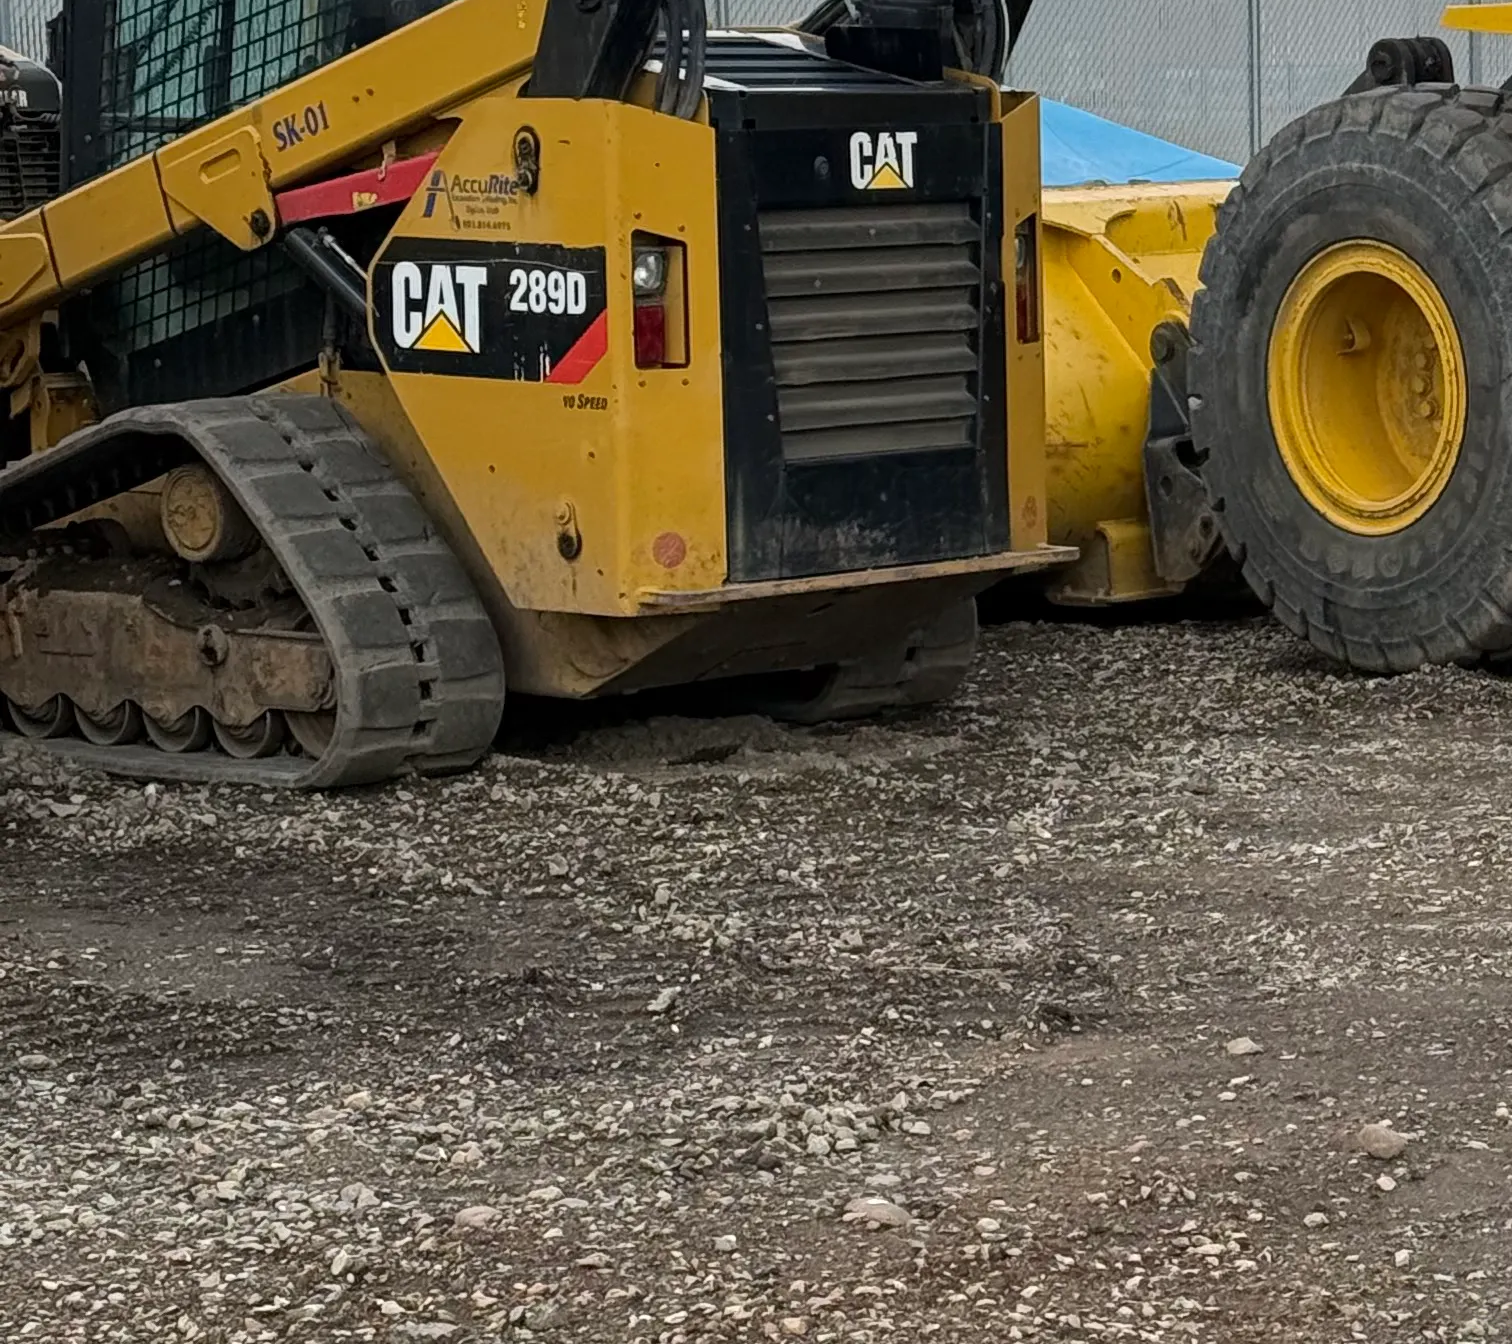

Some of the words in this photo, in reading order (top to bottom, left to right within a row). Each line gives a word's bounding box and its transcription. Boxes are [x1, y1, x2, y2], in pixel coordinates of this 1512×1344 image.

[272, 100, 330, 153] SK-01
[450, 174, 519, 196] AccuRite
[850, 131, 918, 190] CAT
[391, 261, 488, 354] CAT
[509, 268, 587, 316] 289D
